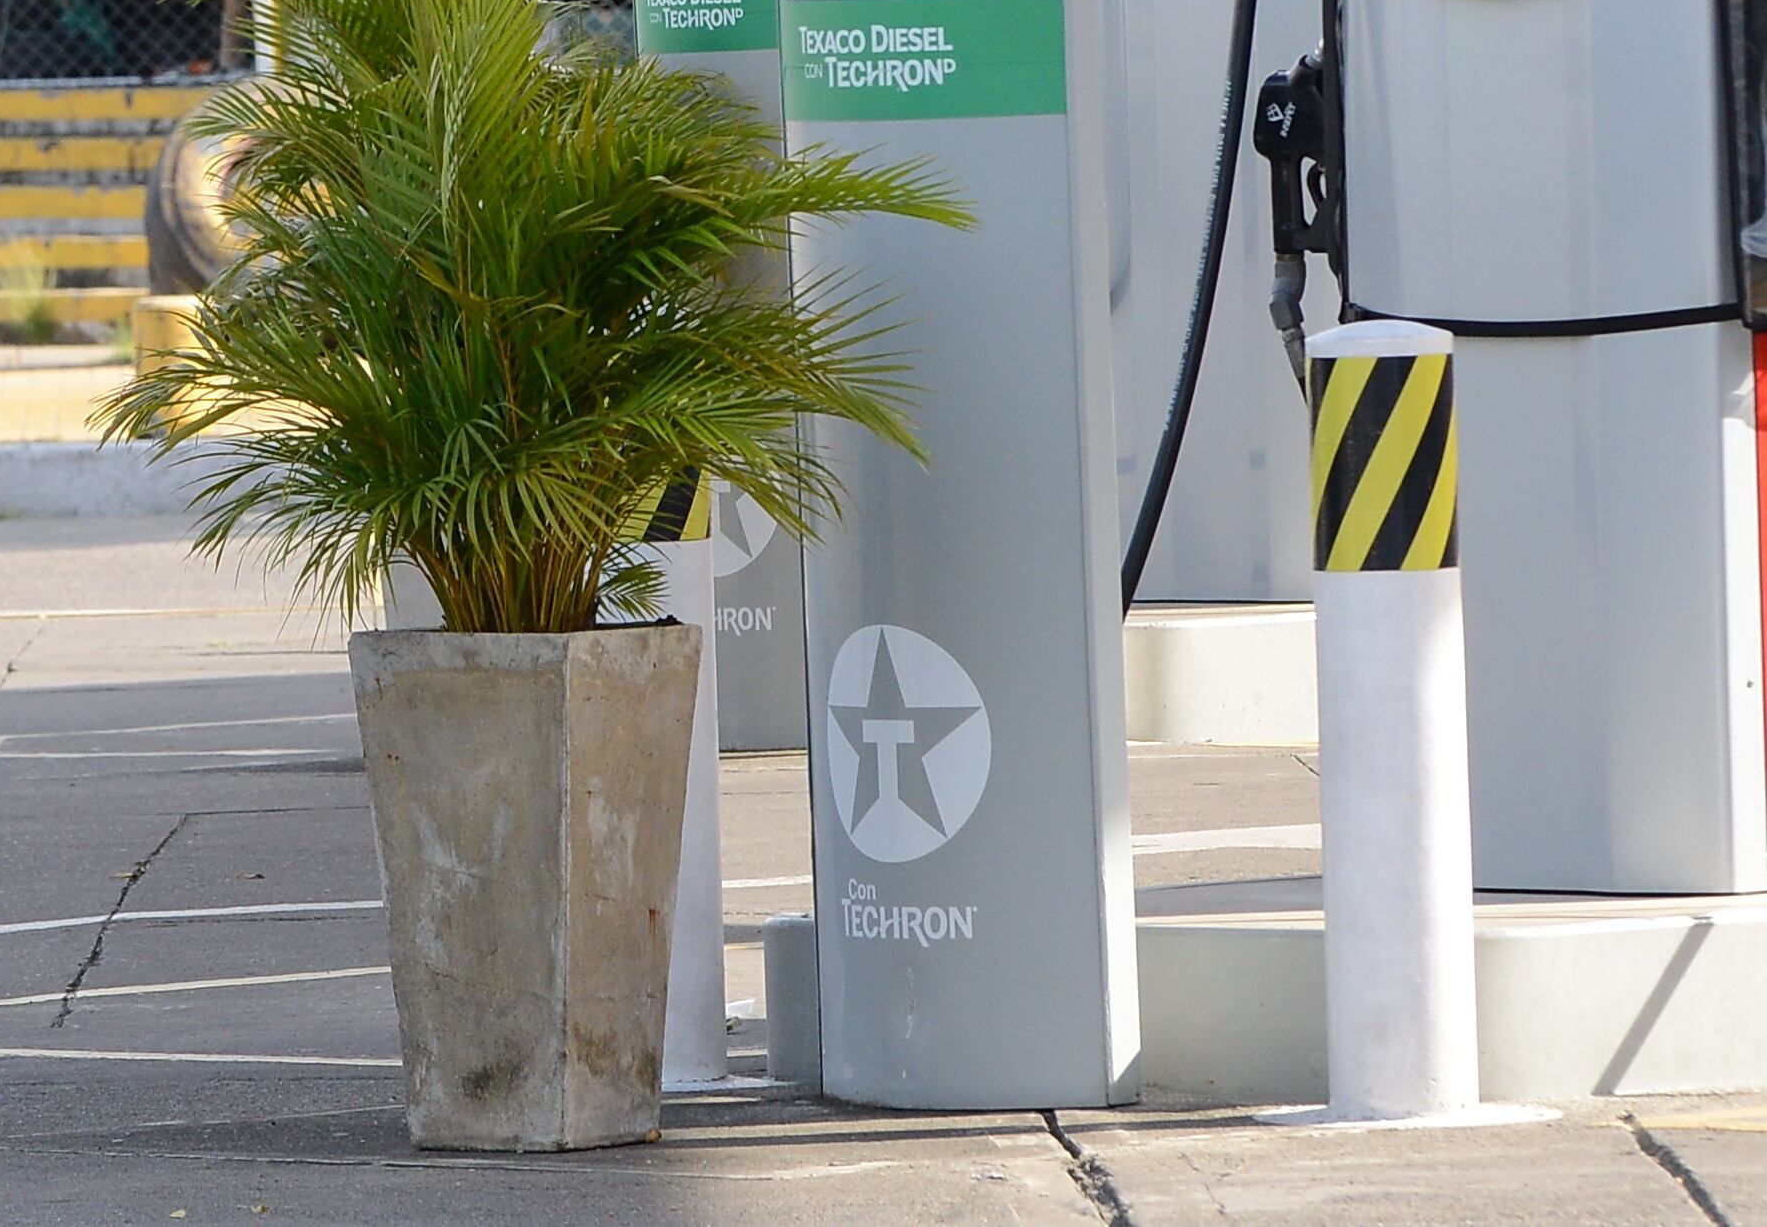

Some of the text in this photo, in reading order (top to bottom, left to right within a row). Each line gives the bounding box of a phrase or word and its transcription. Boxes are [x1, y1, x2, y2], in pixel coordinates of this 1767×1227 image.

[799, 24, 953, 54] TEXACO DIESEL
[848, 878, 877, 902] Con
[841, 898, 977, 947] TECHRON
